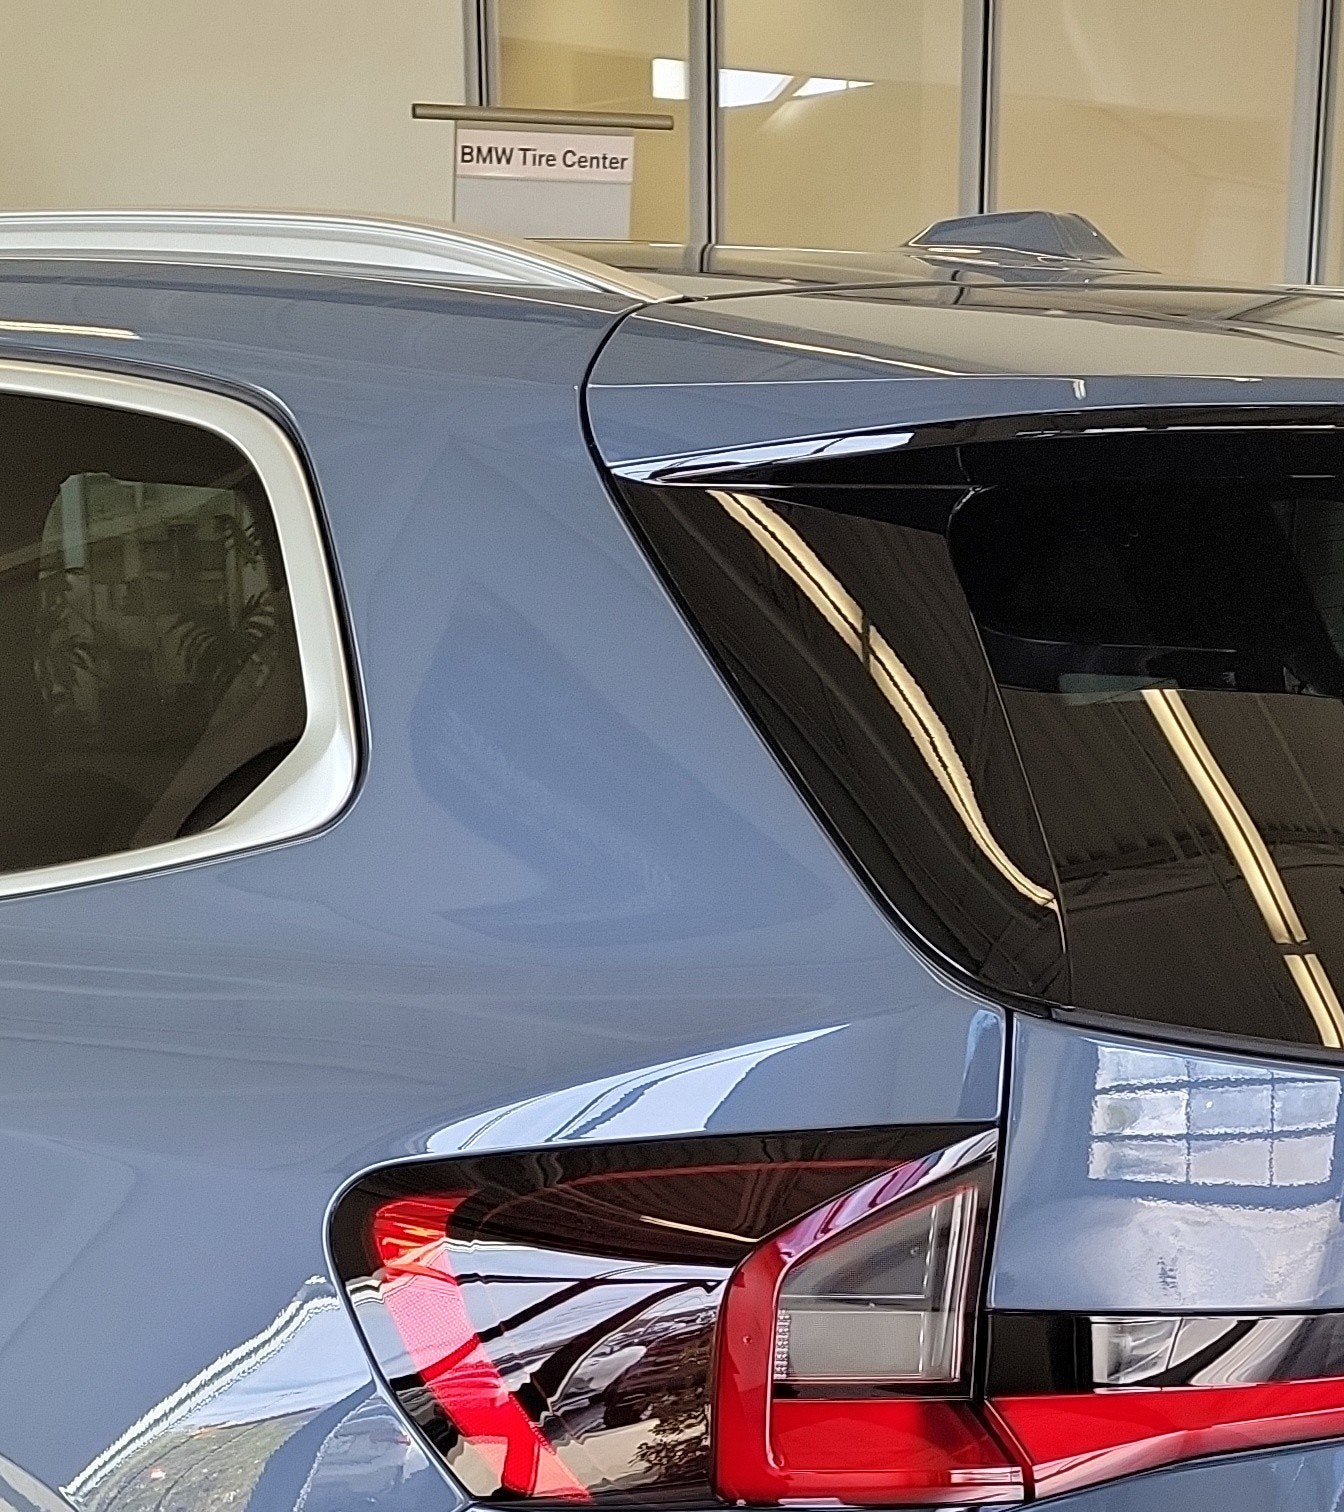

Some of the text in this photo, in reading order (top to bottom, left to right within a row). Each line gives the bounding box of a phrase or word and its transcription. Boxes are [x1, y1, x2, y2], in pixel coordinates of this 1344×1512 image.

[460, 145, 628, 170] BMW Tire Center
